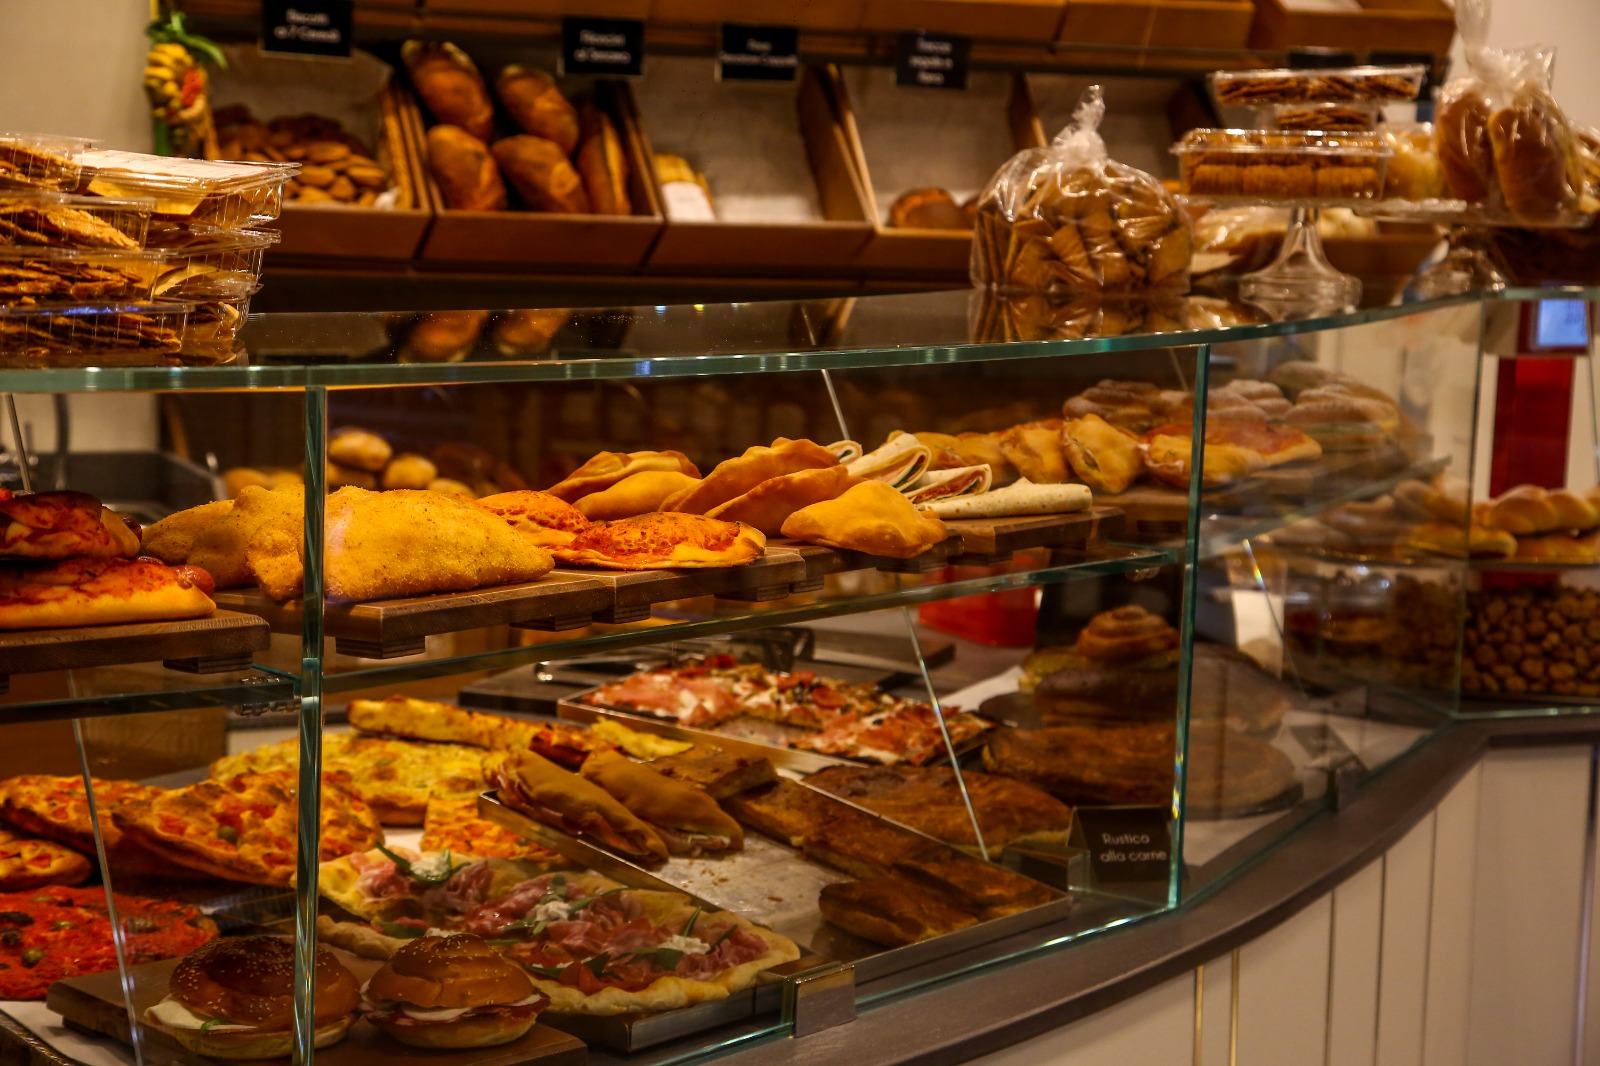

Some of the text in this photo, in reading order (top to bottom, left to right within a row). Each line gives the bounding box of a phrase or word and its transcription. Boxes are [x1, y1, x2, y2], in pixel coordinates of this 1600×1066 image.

[1102, 832, 1150, 845] Rustico
[1101, 850, 1167, 862] alla carne
